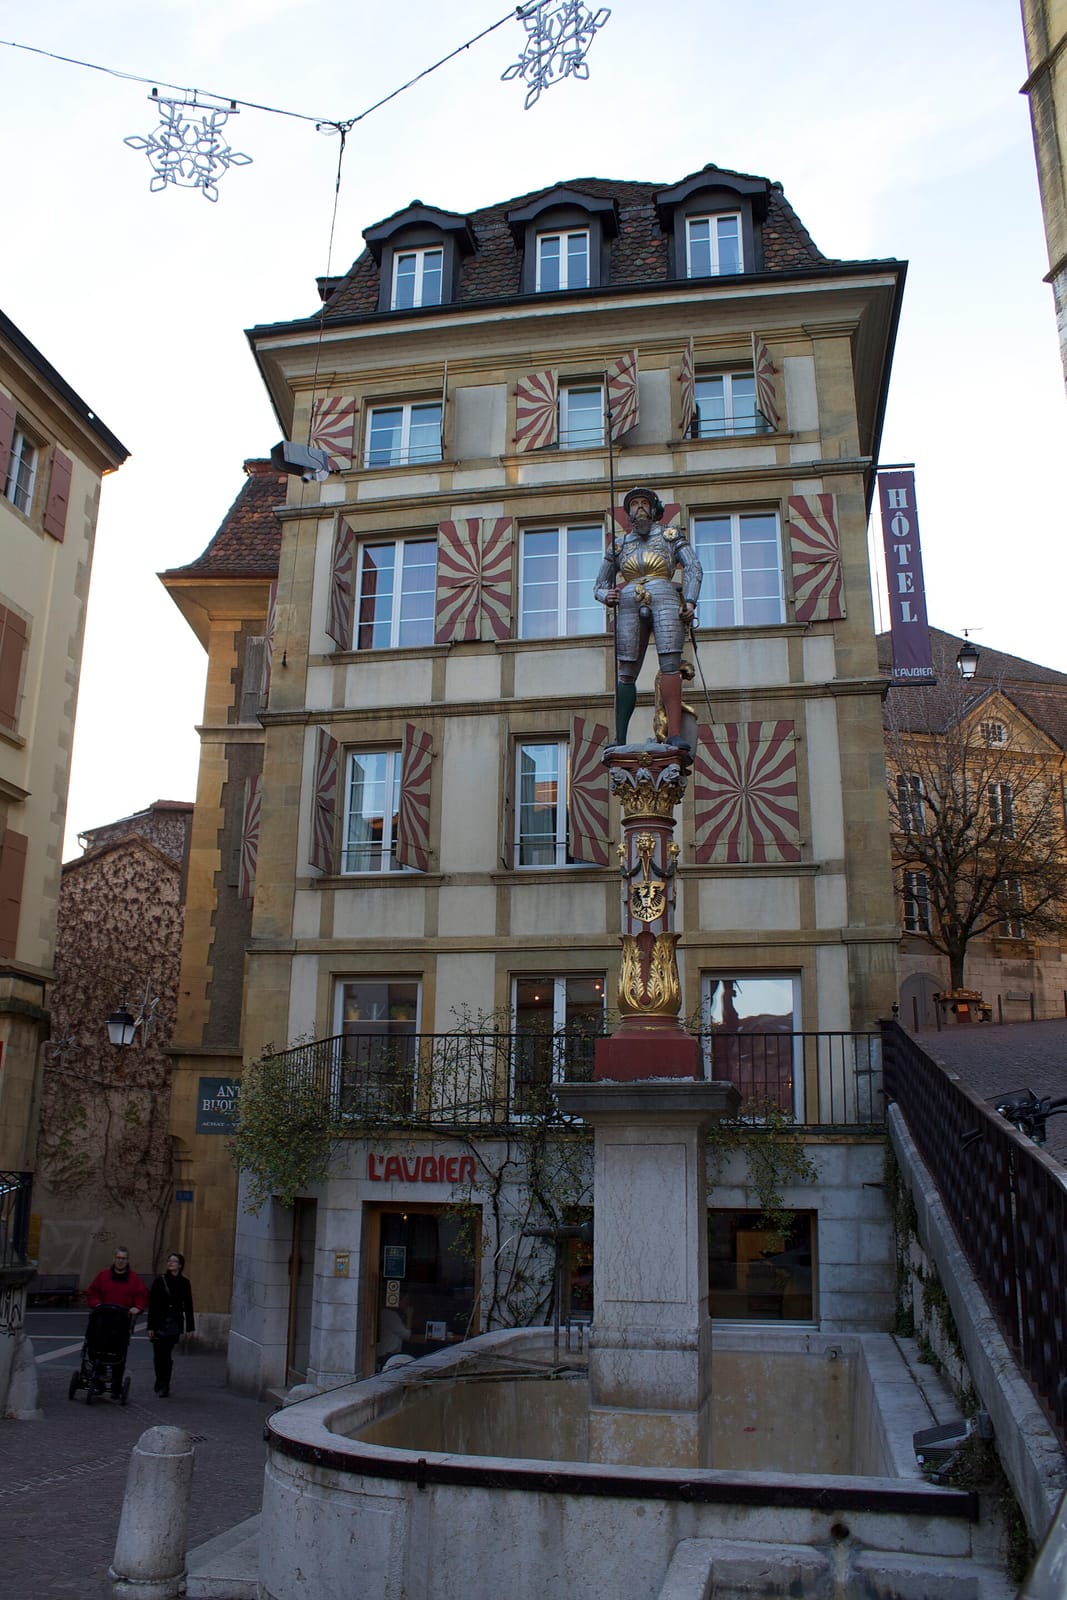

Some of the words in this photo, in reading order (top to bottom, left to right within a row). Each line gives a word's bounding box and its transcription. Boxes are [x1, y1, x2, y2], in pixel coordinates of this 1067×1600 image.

[887, 488, 919, 623] HÔTEL
[894, 666, 933, 678] L'AUBIER
[368, 1152, 477, 1184] L'AUBIER
